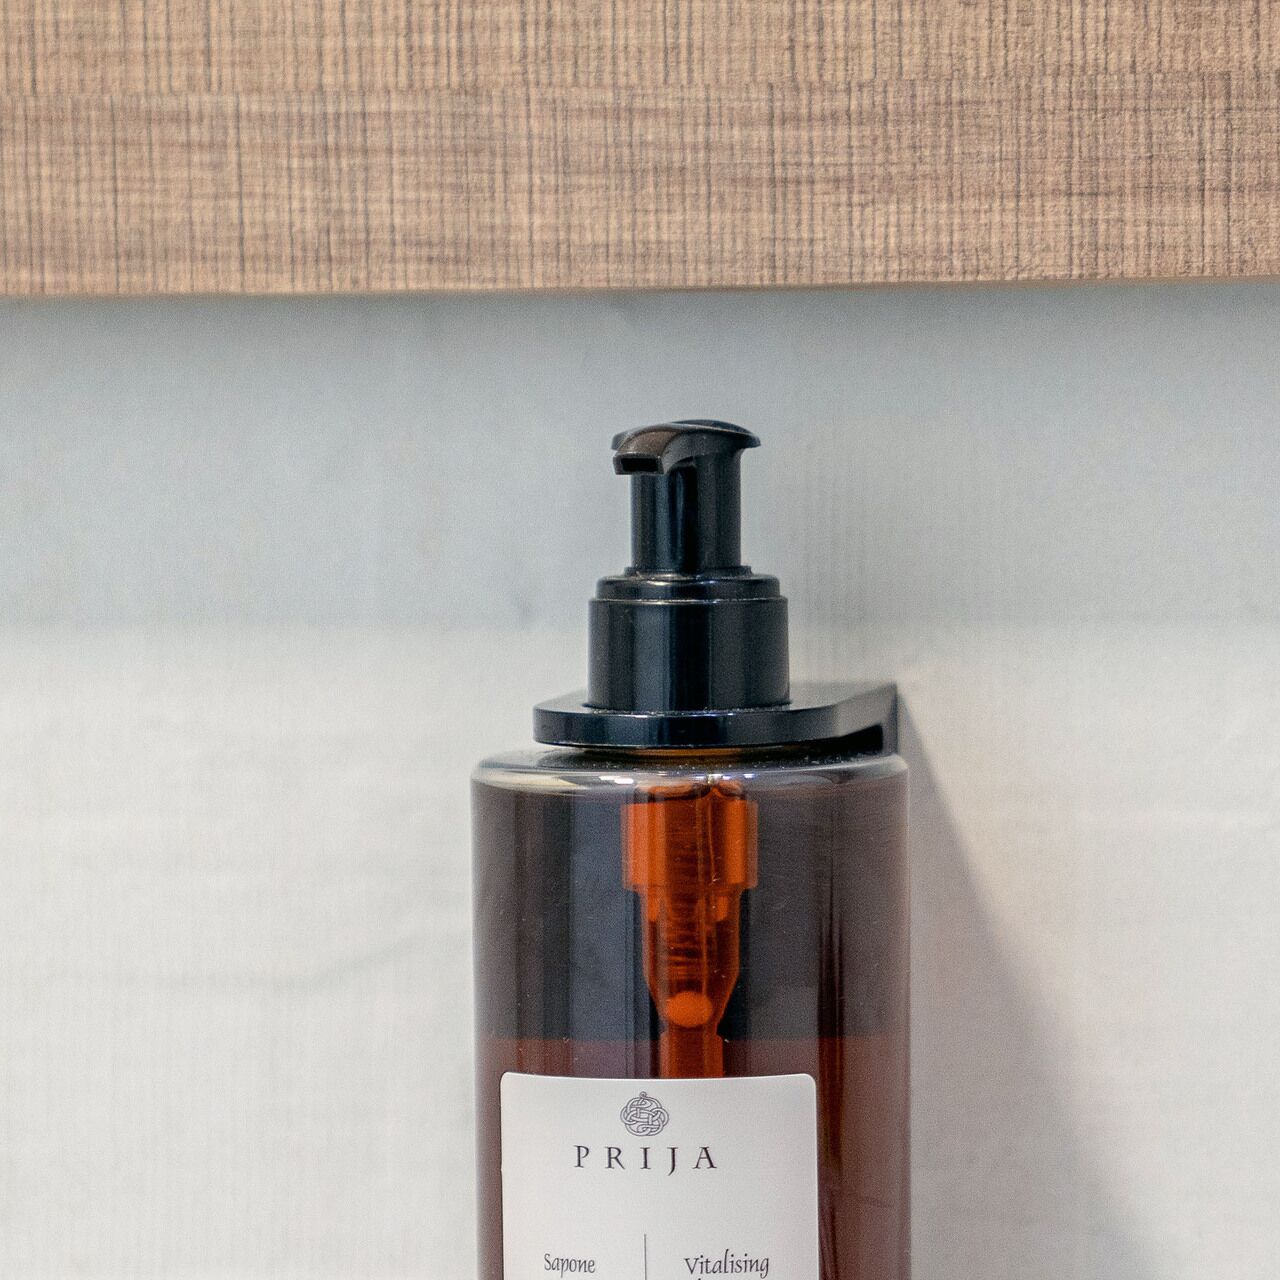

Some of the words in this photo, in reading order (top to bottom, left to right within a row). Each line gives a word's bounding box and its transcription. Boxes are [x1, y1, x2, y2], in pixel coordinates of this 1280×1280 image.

[573, 1145, 718, 1176] PRIJA
[543, 1253, 596, 1278] Sapone
[684, 1248, 770, 1279] Vitalising
